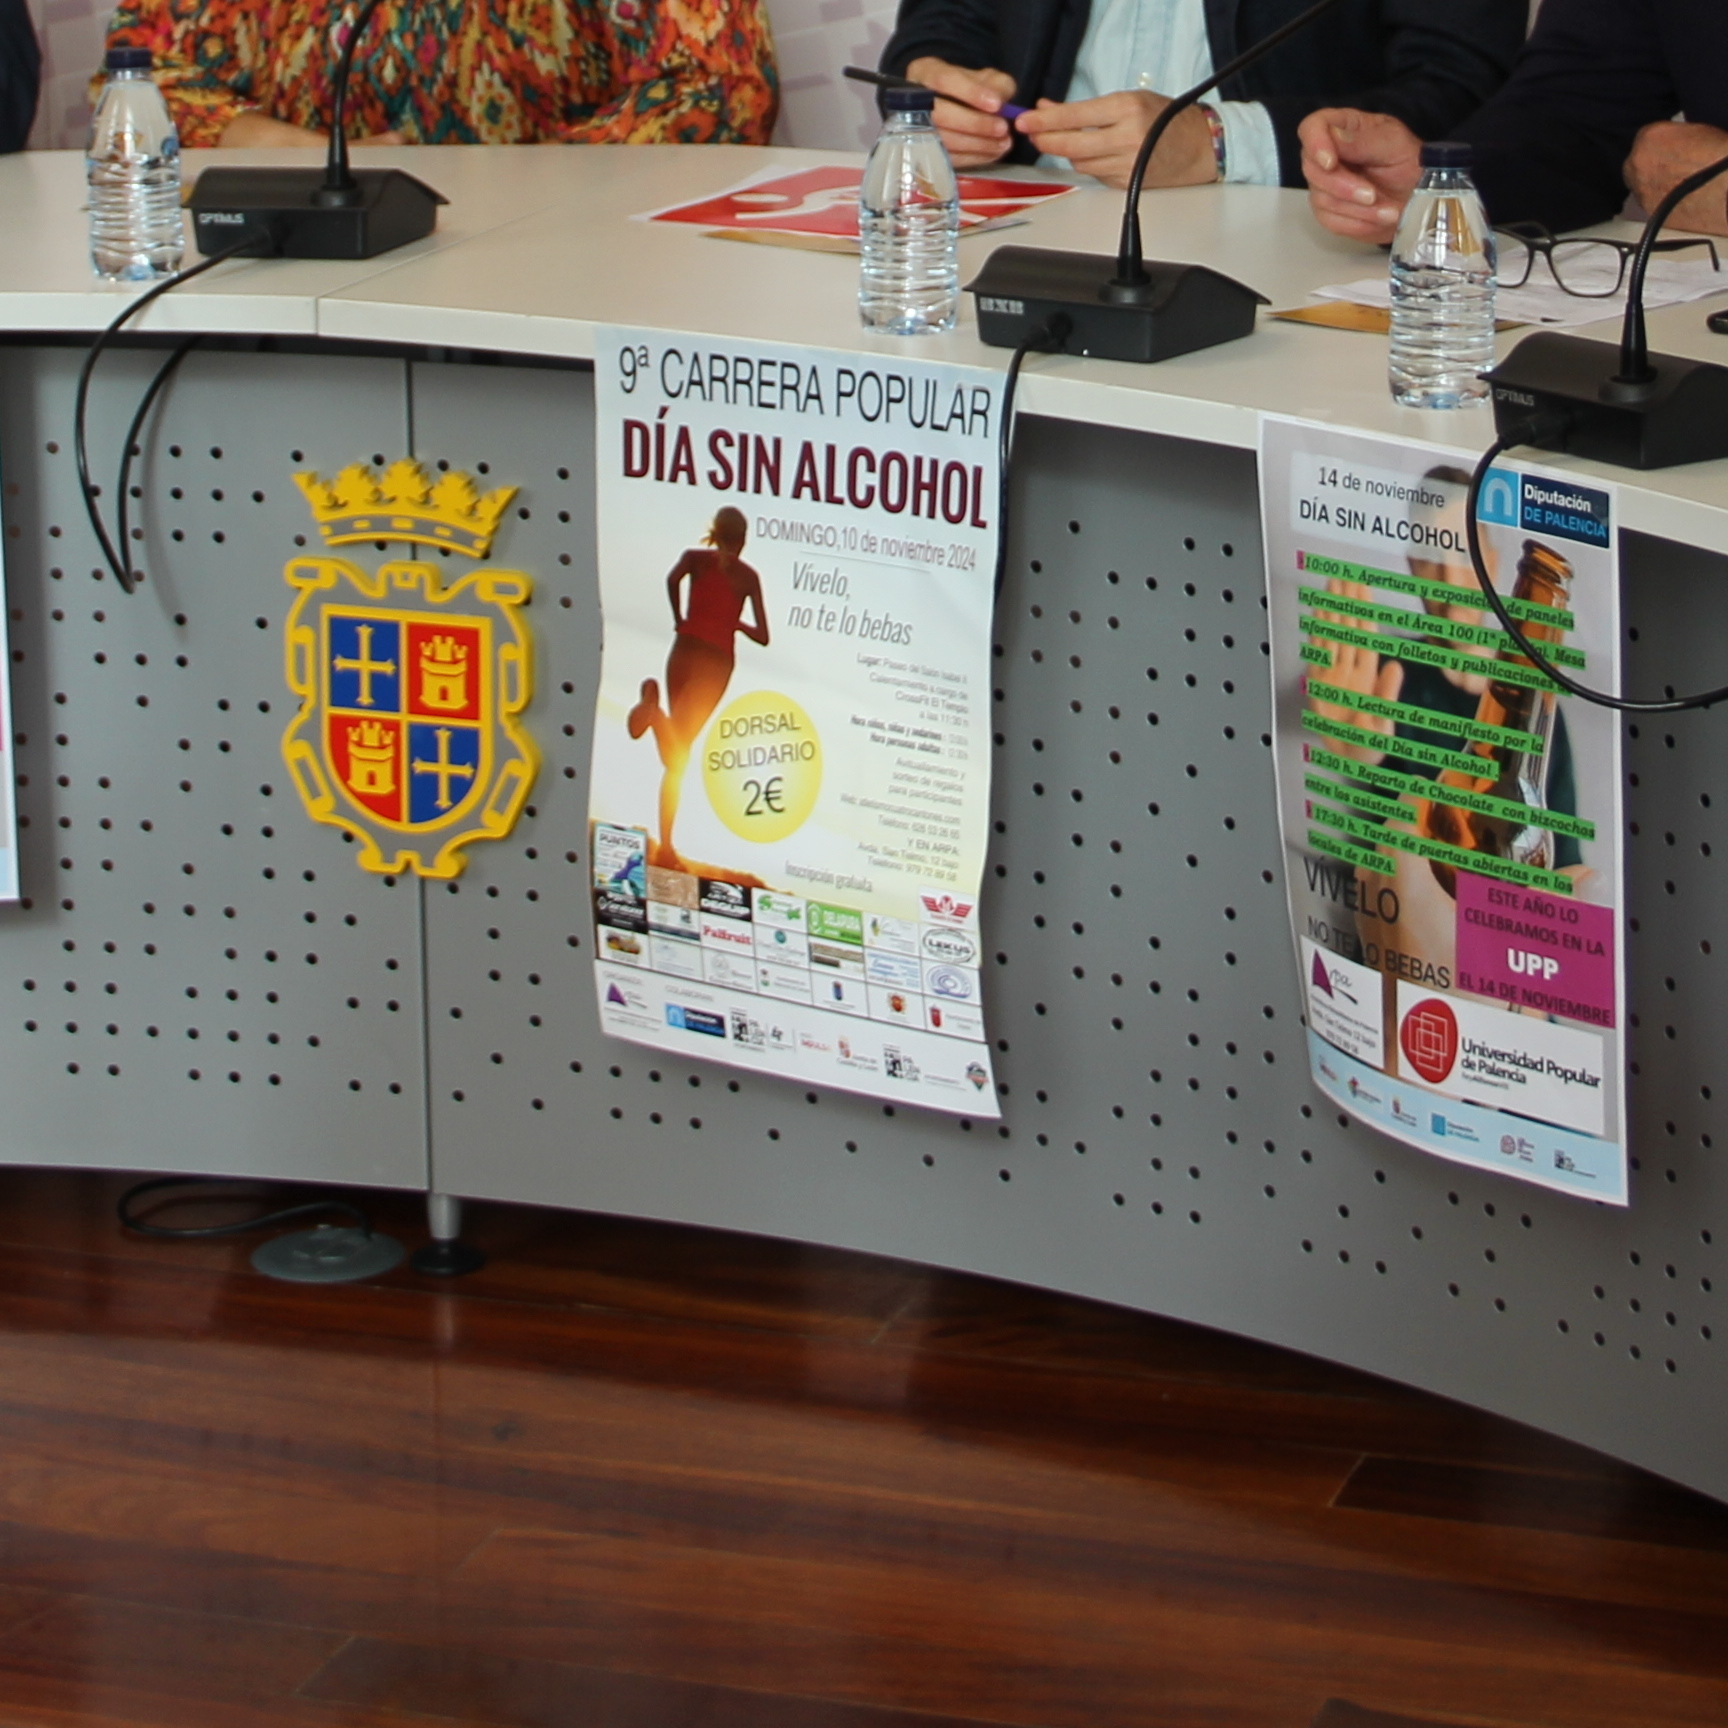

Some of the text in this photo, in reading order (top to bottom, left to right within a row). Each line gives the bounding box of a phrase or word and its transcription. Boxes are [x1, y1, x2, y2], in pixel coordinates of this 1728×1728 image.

[620, 343, 992, 438] 9ª CARRERA POPULAR
[623, 407, 988, 528] DÍA SIN ALCOHOL
[1318, 466, 1445, 508] 14 de noviembre
[1524, 484, 1591, 513] Diputación
[1299, 495, 1466, 553] DÍA SIN ALCOHOL
[1524, 505, 1607, 538] DE PALENCIA
[861, 533, 878, 553] de
[881, 538, 945, 565] noviembre
[947, 544, 977, 571] 2024
[792, 561, 851, 600] Vívelo,
[788, 604, 913, 645] no te lo bebas
[1298, 589, 1473, 640] informativos en el Área 100
[1299, 646, 1332, 666] ARPA.
[720, 713, 801, 739] DORSAL
[708, 741, 816, 772] SOLIDARIO
[742, 777, 786, 817] 2€
[1304, 856, 1399, 924] VÍVELO
[1488, 888, 1579, 924] ESTE AÑO LO
[1308, 916, 1450, 989] NO TE BEBAS
[1465, 909, 1605, 957] CELEBRAMOS EN LA
[1507, 948, 1559, 980] UPP
[1459, 974, 1611, 1025] EL 14 DE NOVIEMBRE
[1461, 1059, 1476, 1073] de
[1477, 1062, 1527, 1085] Palencia
[1462, 1037, 1545, 1073] Universidad
[1546, 1059, 1601, 1089] Popular
